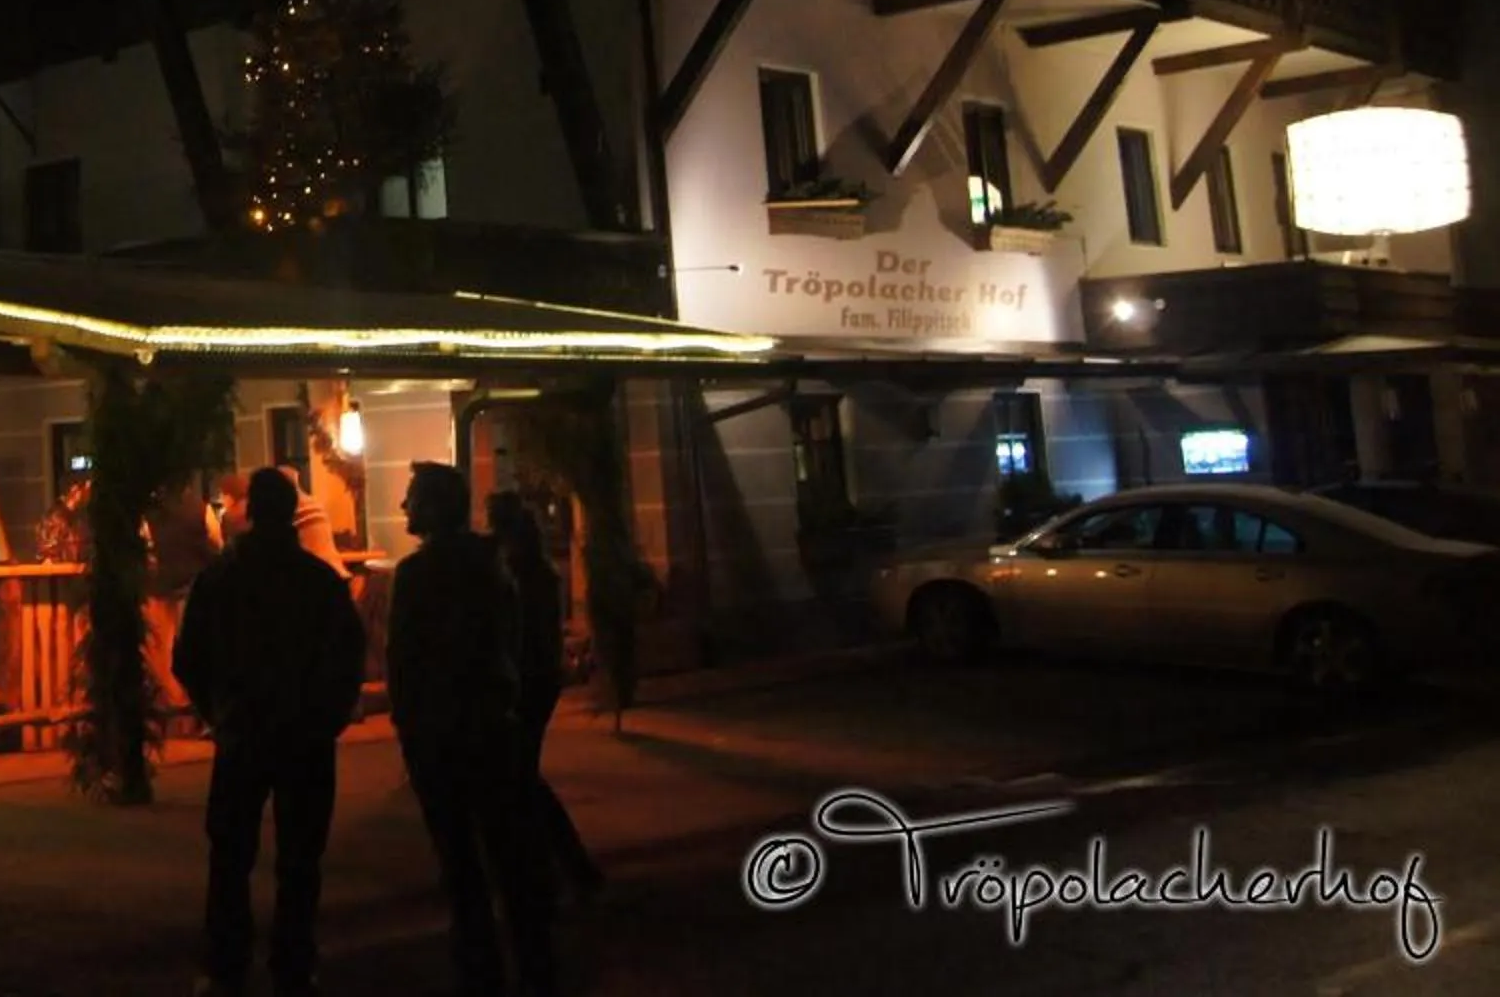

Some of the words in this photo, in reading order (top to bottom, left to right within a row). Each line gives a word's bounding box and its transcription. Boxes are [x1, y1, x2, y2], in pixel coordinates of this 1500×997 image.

[876, 251, 932, 274] Der
[763, 268, 966, 304] Tröpolacher
[979, 282, 1028, 309] Hof
